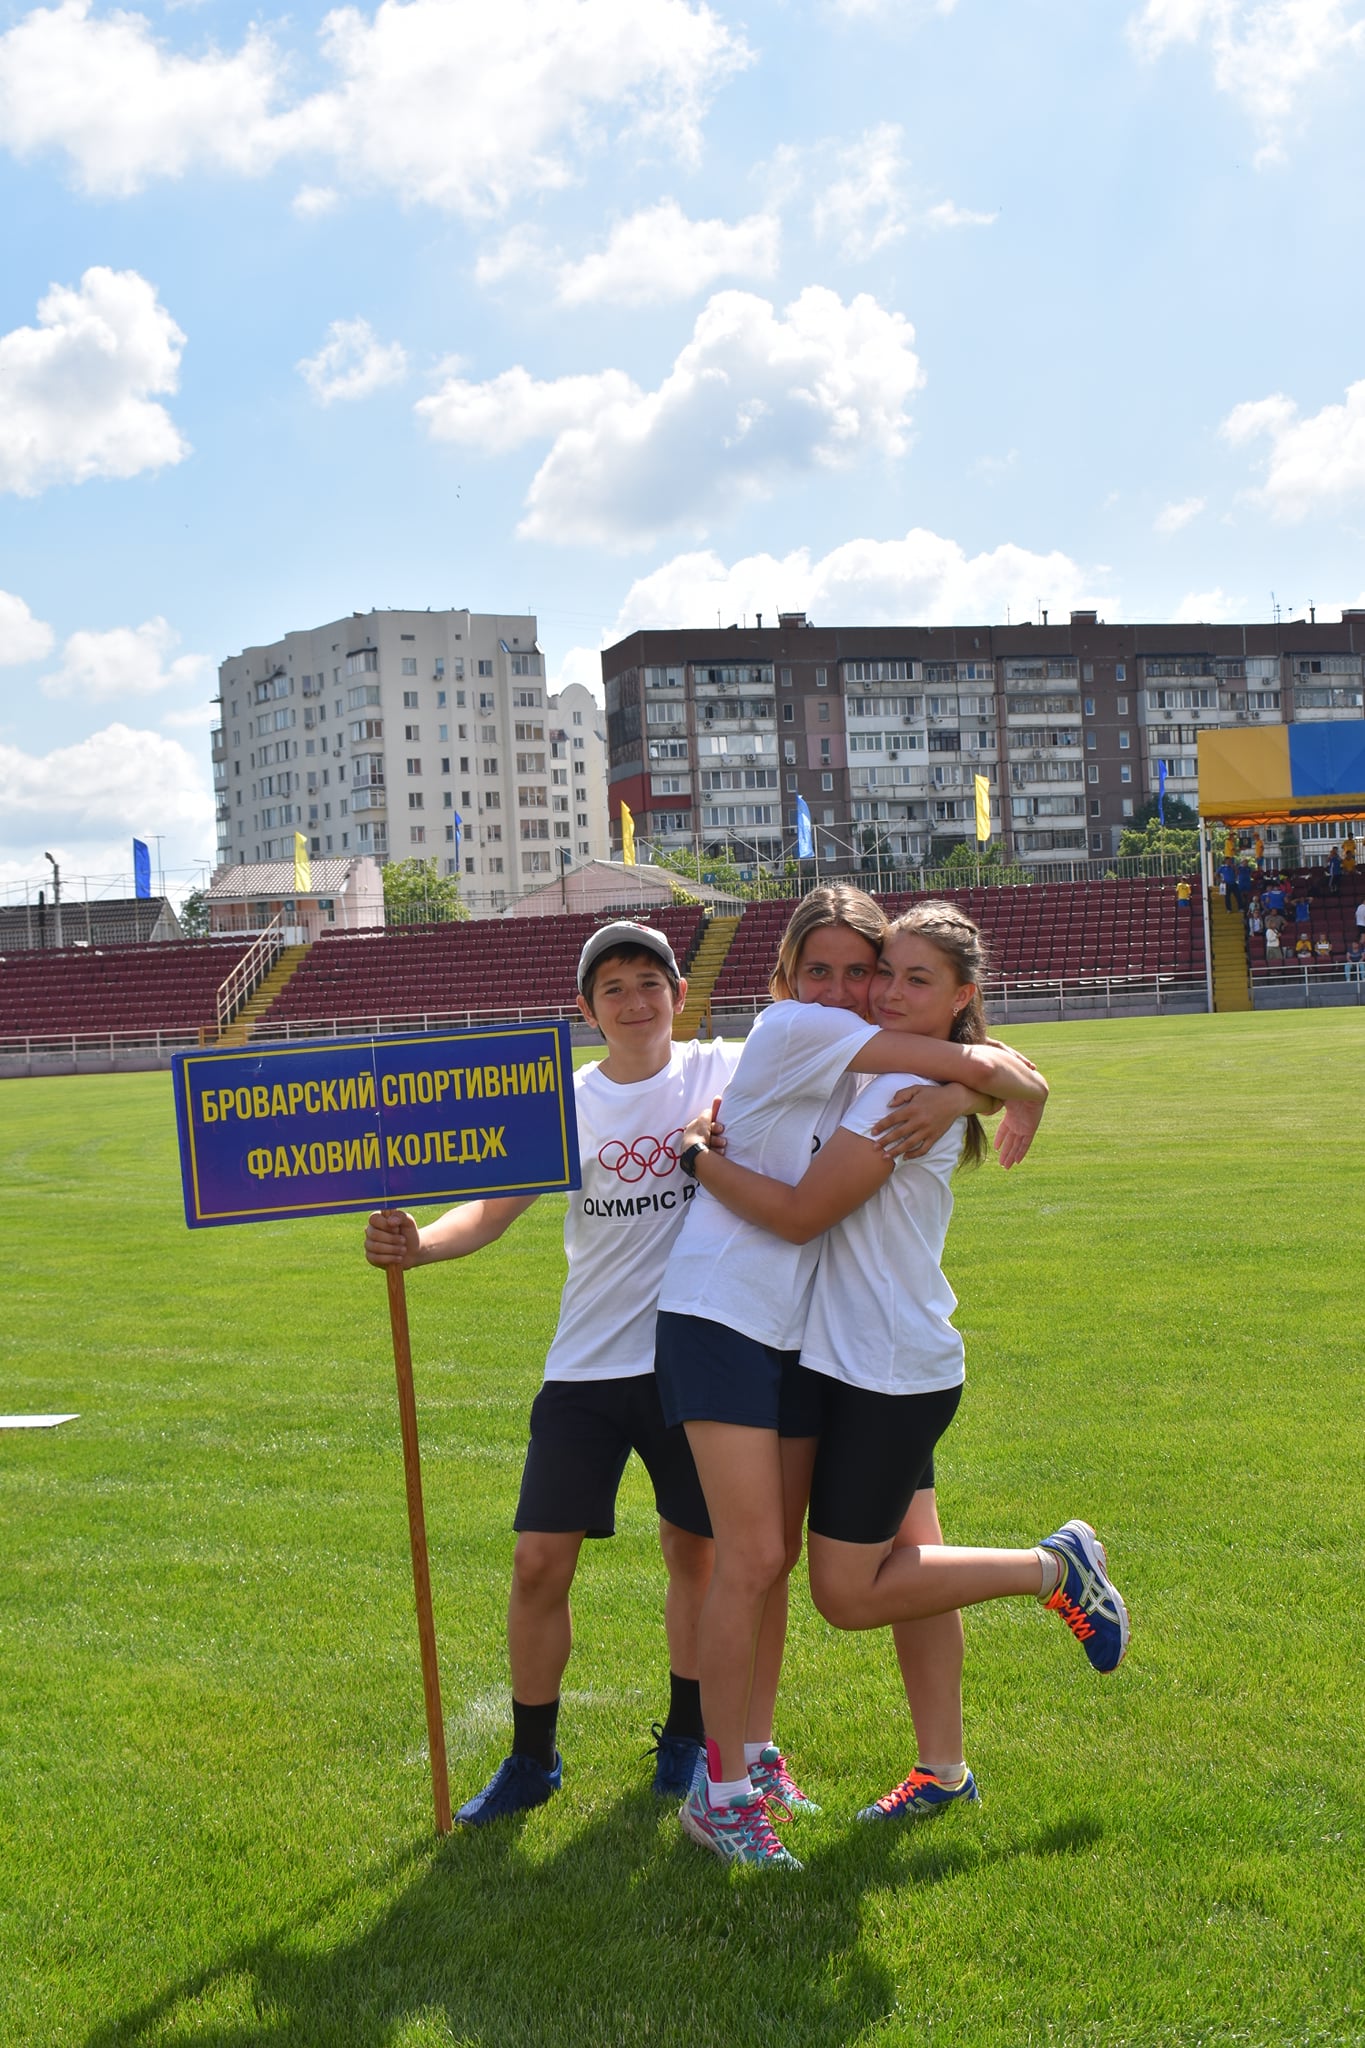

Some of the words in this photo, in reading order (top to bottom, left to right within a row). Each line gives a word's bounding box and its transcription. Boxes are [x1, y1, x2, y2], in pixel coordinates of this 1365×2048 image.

[201, 1072, 376, 1123] БРОВАРСКИЙ
[382, 1056, 555, 1106] СПОРТИВНИЙ
[248, 1133, 381, 1180] ФАХОВИЙ
[387, 1126, 507, 1167] КОЛЕДЖ
[584, 1191, 676, 1217] OLYMPIC
